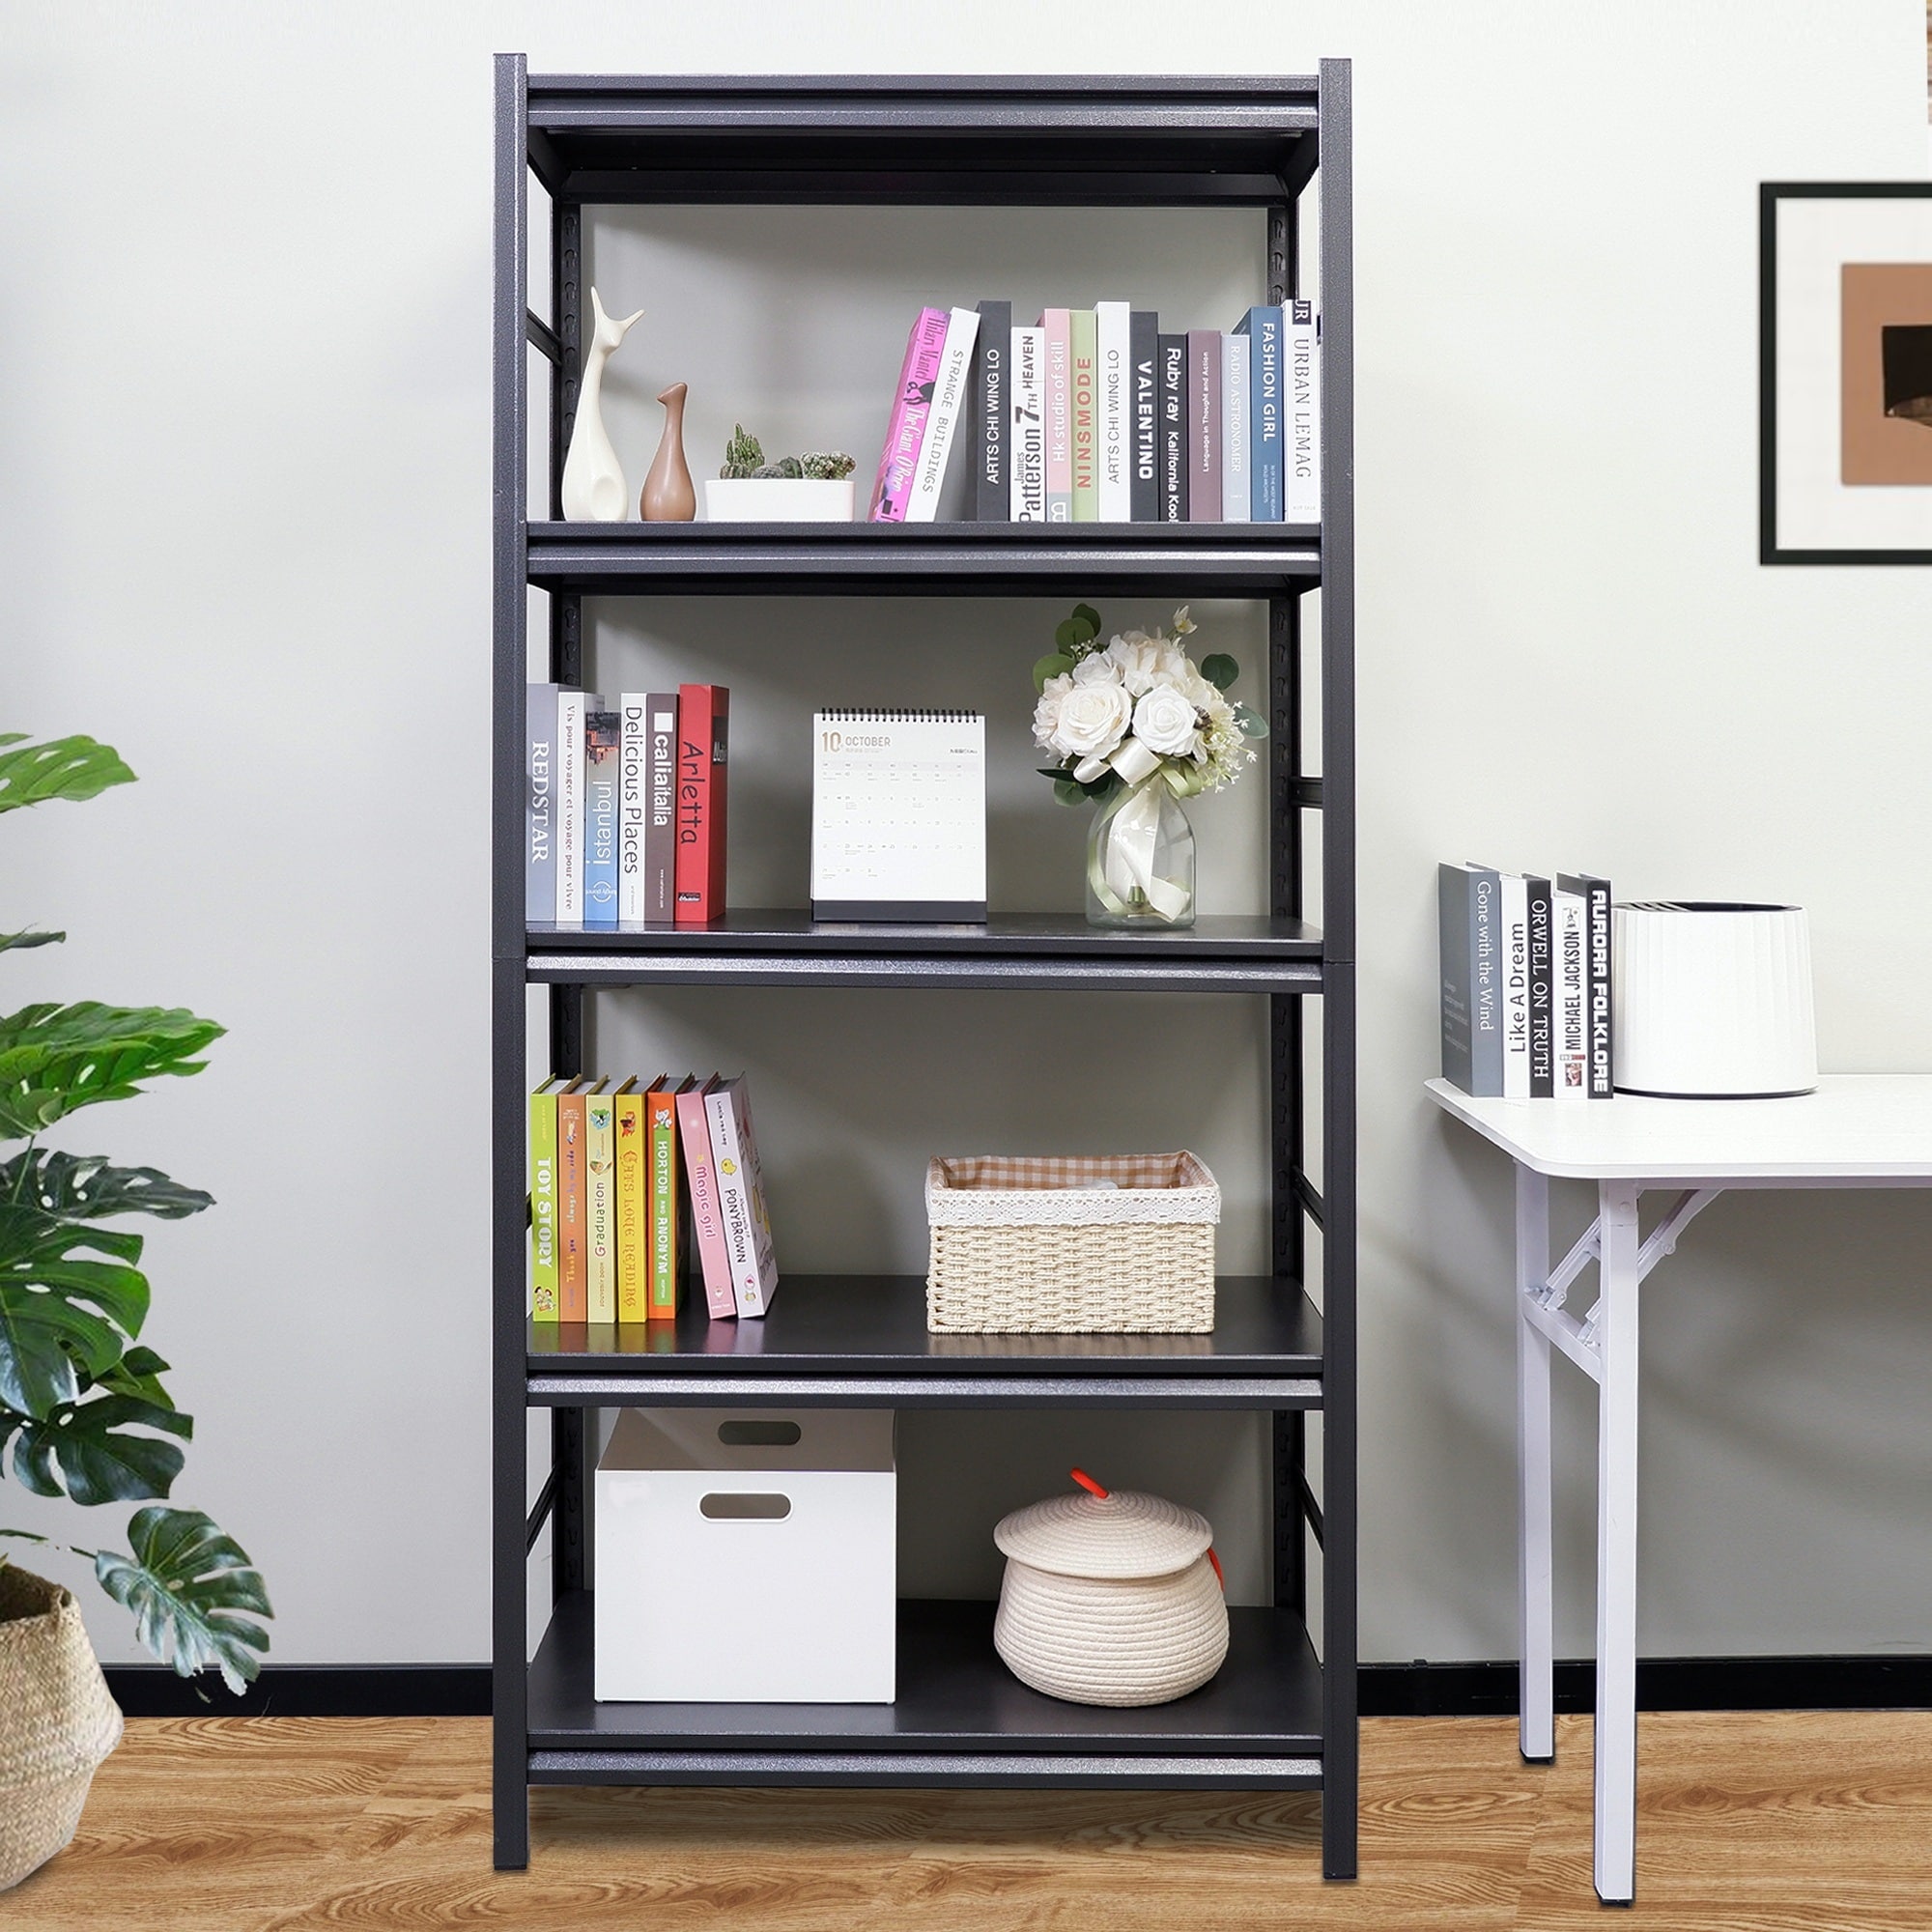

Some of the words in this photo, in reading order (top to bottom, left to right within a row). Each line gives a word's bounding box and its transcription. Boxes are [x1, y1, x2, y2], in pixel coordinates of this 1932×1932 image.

[986, 349, 1000, 371] LO
[1022, 335, 1034, 389] HEAVEN
[1051, 341, 1065, 371] skill
[1107, 350, 1120, 369] LO
[1166, 348, 1181, 392] Ruby
[1231, 346, 1241, 384] RADIO
[1263, 323, 1275, 398] FASHION
[1294, 338, 1311, 404] URBAN
[941, 350, 964, 409] STRANGE
[986, 373, 1000, 413] WING
[1051, 374, 1065, 390] of
[1107, 372, 1120, 412] WING
[986, 416, 1000, 440] CHI
[1051, 394, 1065, 439] studio
[1077, 357, 1092, 488] NINSMODE
[1107, 417, 1120, 441] CHI
[1137, 360, 1153, 480] VALENTINO
[1166, 397, 1179, 422] ray
[1231, 389, 1243, 472] ASTRONOMER
[1263, 404, 1276, 441] GIRL
[923, 416, 950, 493] BUILDINGS
[986, 446, 1000, 485] ARTS
[1014, 451, 1025, 483] James
[1053, 444, 1065, 462] Hk
[1107, 445, 1120, 484] ARTS
[1168, 432, 1181, 492] Kalifornia
[1294, 412, 1312, 478] LEMAG
[1019, 428, 1041, 522] Patterson
[564, 725, 574, 749] pour
[624, 706, 642, 803] Delicious
[822, 731, 841, 753] 10
[845, 736, 891, 748] OCTOBER
[564, 753, 574, 795] voyager
[654, 735, 674, 827] caliaitalia
[681, 741, 706, 844] Arletta
[531, 741, 550, 864] REDSTAR
[564, 813, 574, 851] voyage
[624, 807, 642, 874] Places
[564, 855, 574, 877] pour
[565, 883, 575, 910] vivre
[1477, 881, 1492, 923] Gone
[1478, 925, 1493, 960] with
[1510, 923, 1524, 987] Dream
[1532, 900, 1548, 976] ORWELL
[1592, 890, 1606, 978] AURORA
[1478, 961, 1493, 984] the
[1563, 931, 1580, 991] JACKSON
[1479, 987, 1494, 1031] Wind
[1510, 992, 1525, 1007] A
[1533, 983, 1548, 1009] ON
[1510, 1011, 1525, 1053] Like
[1564, 994, 1581, 1050] MICHAEL
[1593, 982, 1607, 1093] FOLKLORE
[1533, 1015, 1548, 1078] TRUTH
[536, 1156, 552, 1197] TOY
[657, 1141, 668, 1195] HORTON
[695, 1166, 710, 1210] Magic
[537, 1202, 553, 1268] STORY
[594, 1181, 606, 1258] Graduation
[698, 1215, 717, 1238] girl
[724, 1188, 747, 1264] PONYBROWN
[657, 1217, 668, 1274] ANONYM
